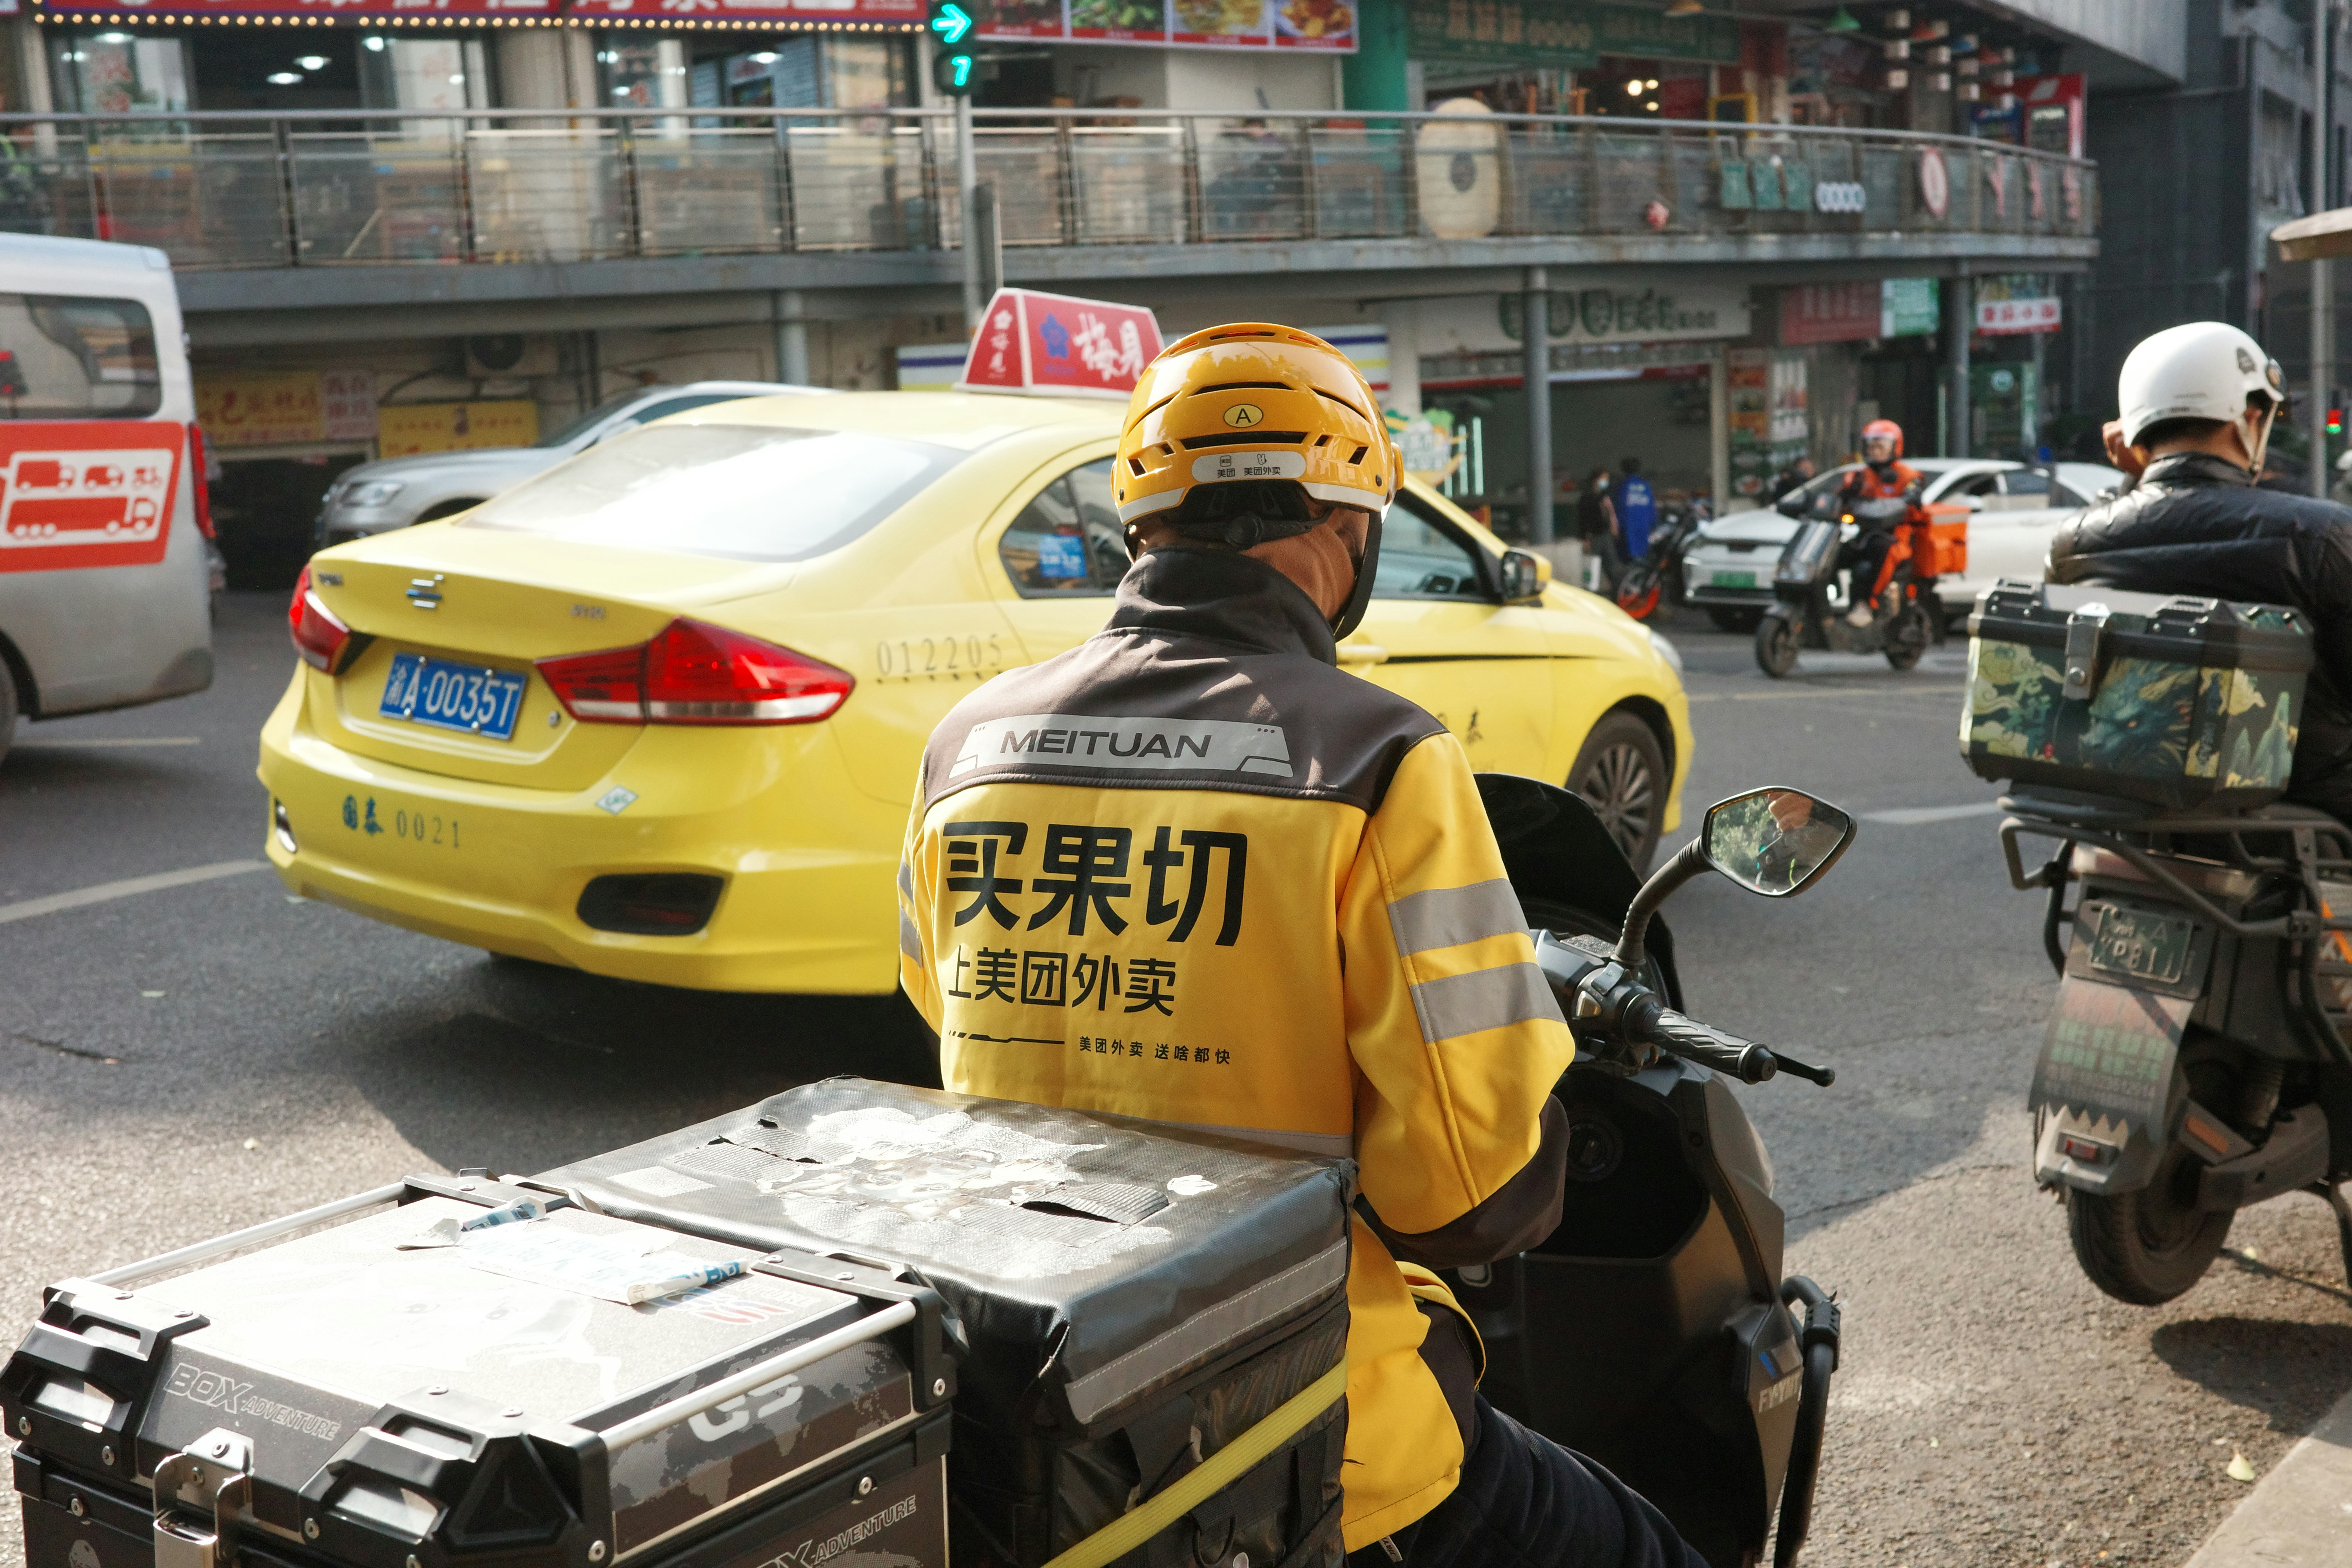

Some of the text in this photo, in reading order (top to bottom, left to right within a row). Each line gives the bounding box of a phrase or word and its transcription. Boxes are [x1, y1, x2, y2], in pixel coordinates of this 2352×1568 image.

[951, 56, 972, 86] 7
[1235, 408, 1252, 424] A
[1217, 466, 1281, 478] 美团 美团外卖
[877, 633, 1002, 675] 012205
[1000, 729, 1212, 759] MEITUAN
[395, 809, 460, 849] 0021
[943, 821, 1248, 947] 买果切
[948, 945, 1176, 1016] 上美团外卖
[1079, 1036, 1231, 1065] 美团外卖 送啥都快
